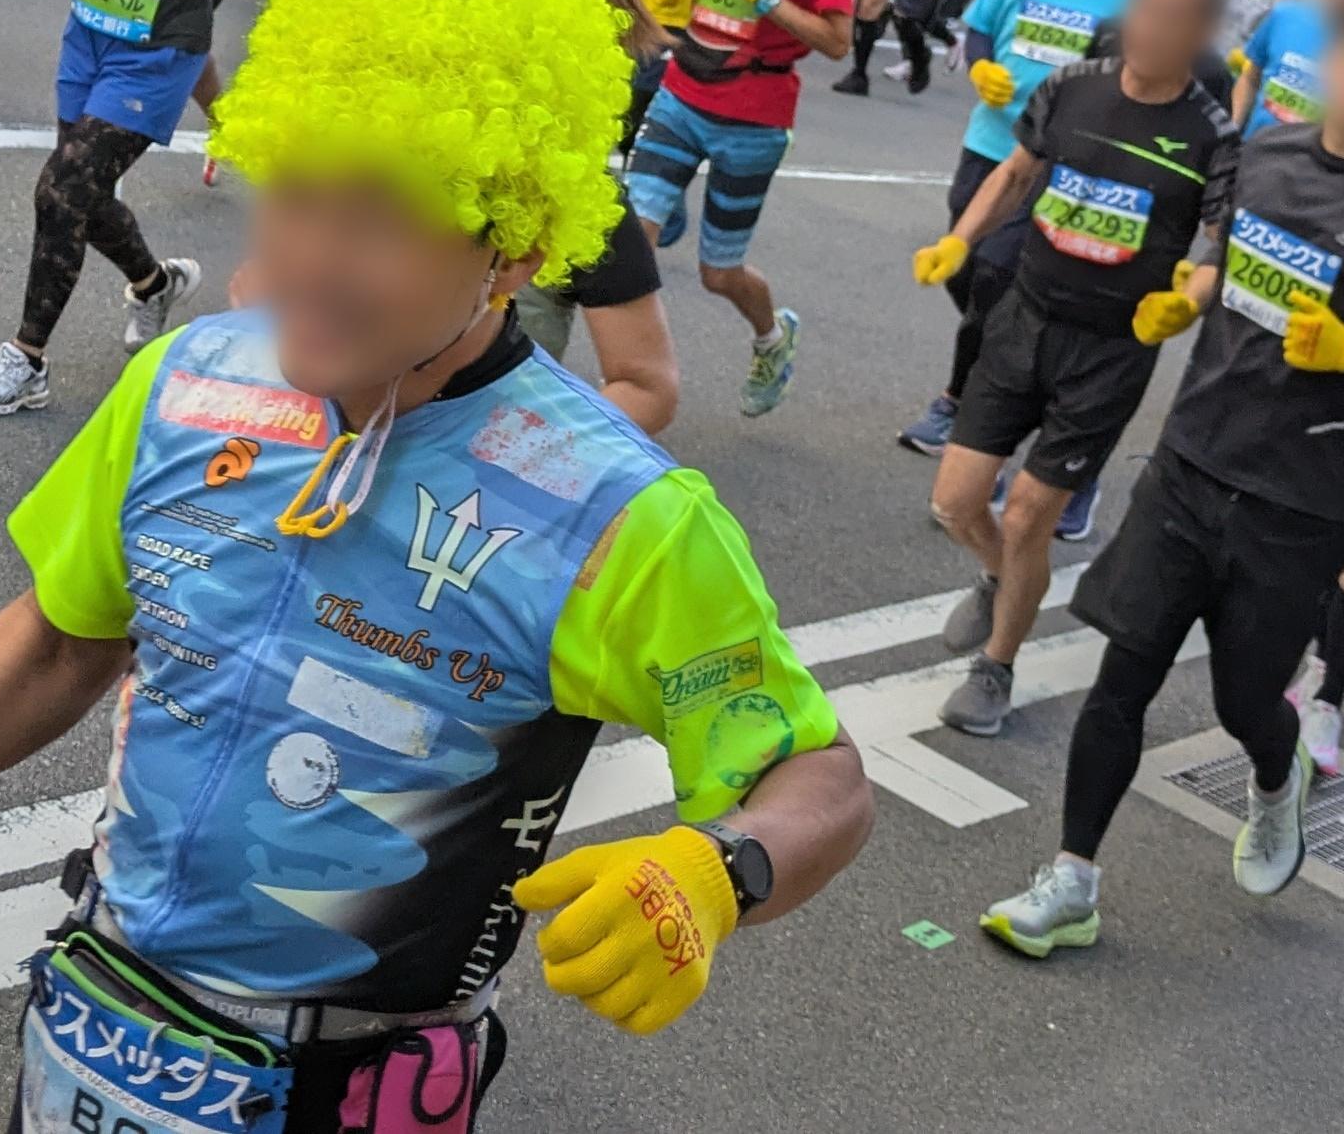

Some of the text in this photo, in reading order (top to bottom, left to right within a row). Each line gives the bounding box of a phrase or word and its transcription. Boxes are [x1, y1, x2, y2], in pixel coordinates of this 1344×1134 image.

[1057, 168, 1140, 212] シスメックス
[1054, 201, 1138, 245] 26293
[1238, 217, 1326, 277] シスメックス
[136, 534, 214, 571] ROAD RACE
[315, 593, 506, 702] Thumbs Up
[623, 858, 696, 978] KOBE
